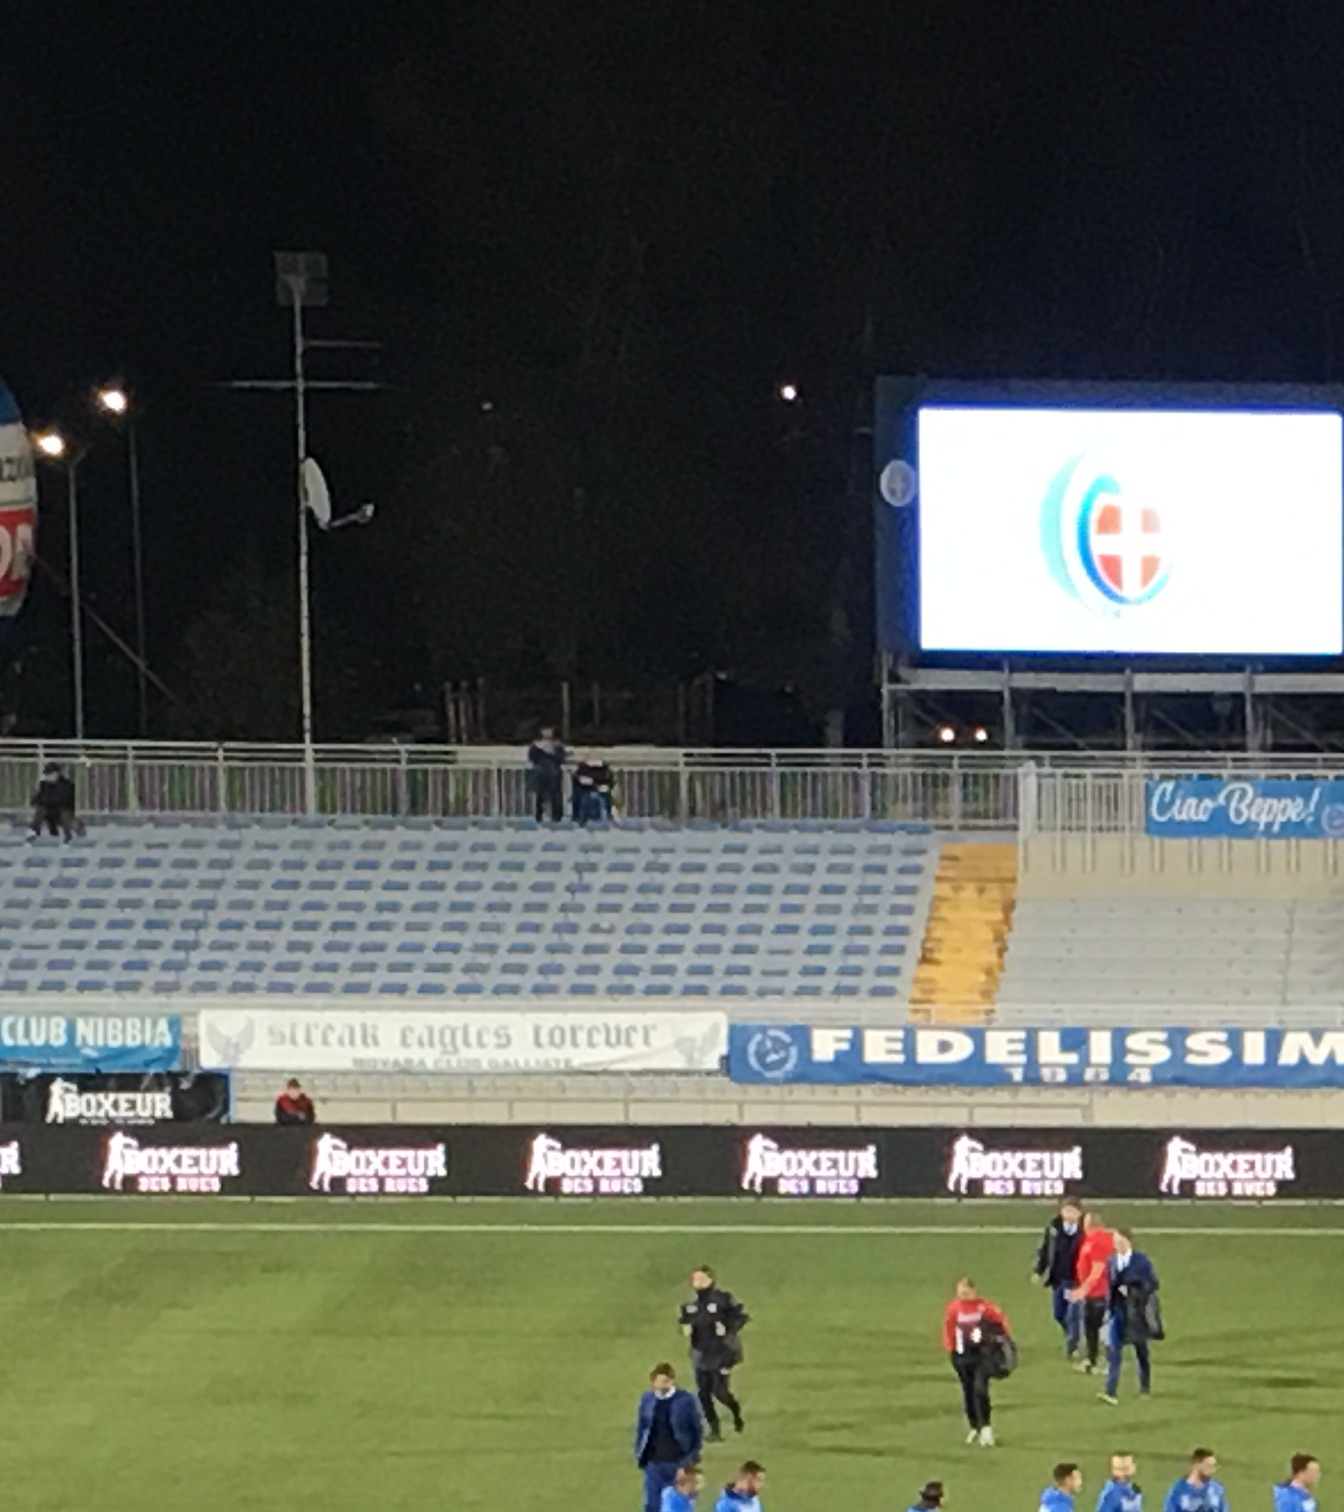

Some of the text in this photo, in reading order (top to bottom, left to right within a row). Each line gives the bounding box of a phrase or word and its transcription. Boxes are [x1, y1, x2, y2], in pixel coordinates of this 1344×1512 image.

[1150, 780, 1322, 834] Ciao Beppe!
[1, 1015, 174, 1048] CLUB NIBBIA
[400, 1022, 513, 1056] eagles
[63, 1089, 174, 1119] BOXEUR
[121, 1145, 240, 1176] BOXEUR
[331, 1145, 447, 1177] BOXEUR
[551, 1146, 662, 1178] BOXEUR
[764, 1147, 878, 1179] BOXEUR
[969, 1148, 1082, 1180] BOXEUR
[1185, 1148, 1295, 1181] BOXEUR
